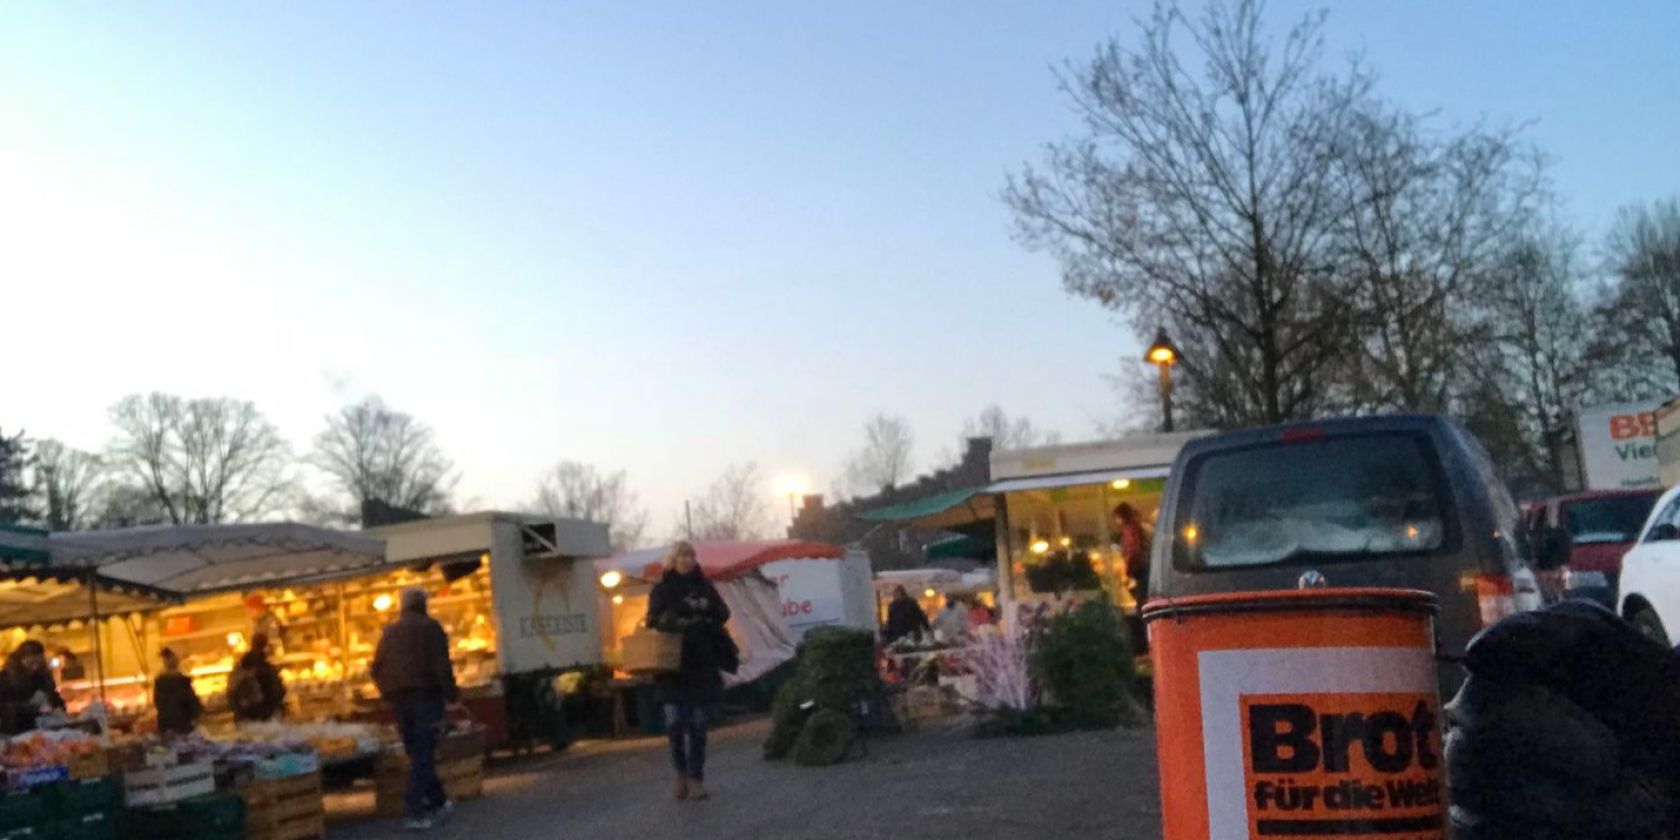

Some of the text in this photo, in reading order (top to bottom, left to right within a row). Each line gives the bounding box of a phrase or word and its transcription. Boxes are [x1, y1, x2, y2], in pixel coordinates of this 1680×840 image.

[1250, 700, 1437, 773] Brot
[1254, 778, 1320, 811] für
[1323, 780, 1386, 810] die
